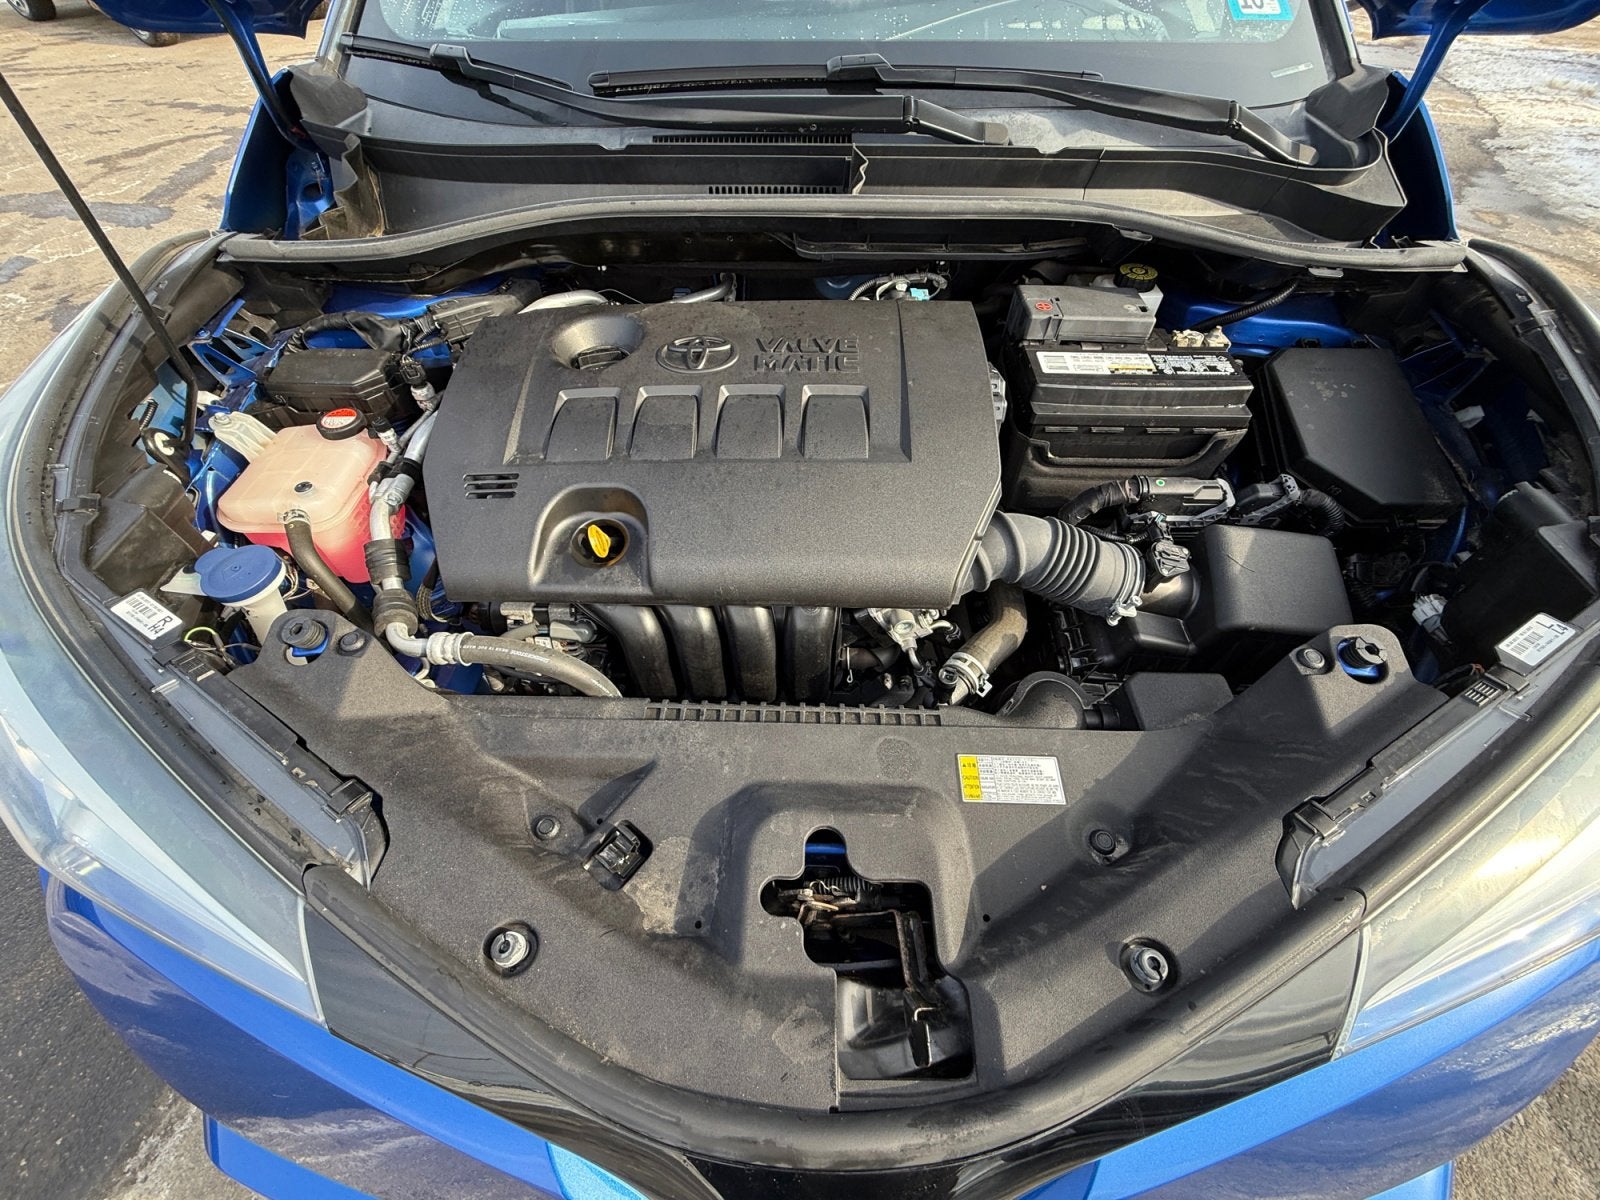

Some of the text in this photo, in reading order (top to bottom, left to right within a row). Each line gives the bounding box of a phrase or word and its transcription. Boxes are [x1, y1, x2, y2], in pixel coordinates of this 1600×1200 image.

[755, 337, 860, 354] VALVE
[753, 354, 860, 373] MATIC
[1535, 620, 1554, 629] L
